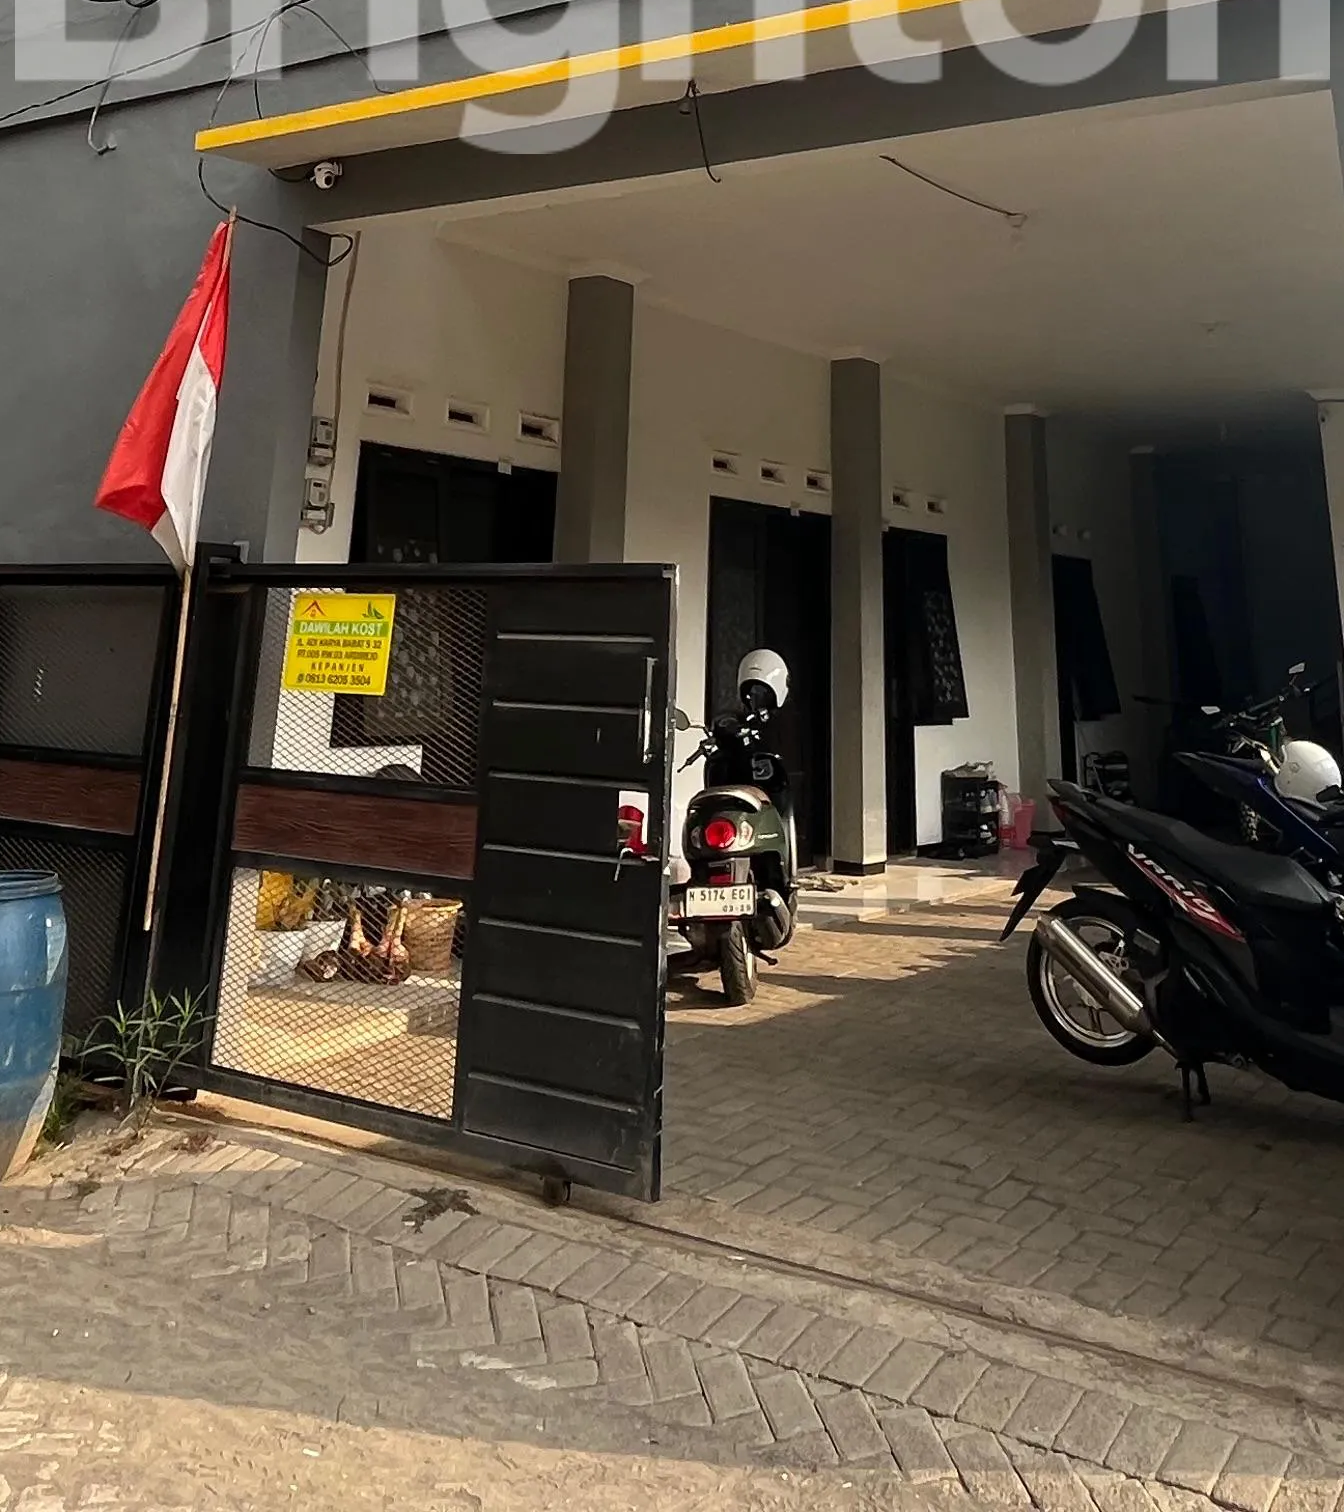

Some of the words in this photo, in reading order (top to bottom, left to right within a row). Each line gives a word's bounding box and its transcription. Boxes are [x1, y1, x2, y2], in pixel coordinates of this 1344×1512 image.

[299, 622, 349, 634] DAWILAH
[351, 623, 383, 636] KOST
[1128, 843, 1216, 913] VARIO
[701, 890, 726, 901] 5174
